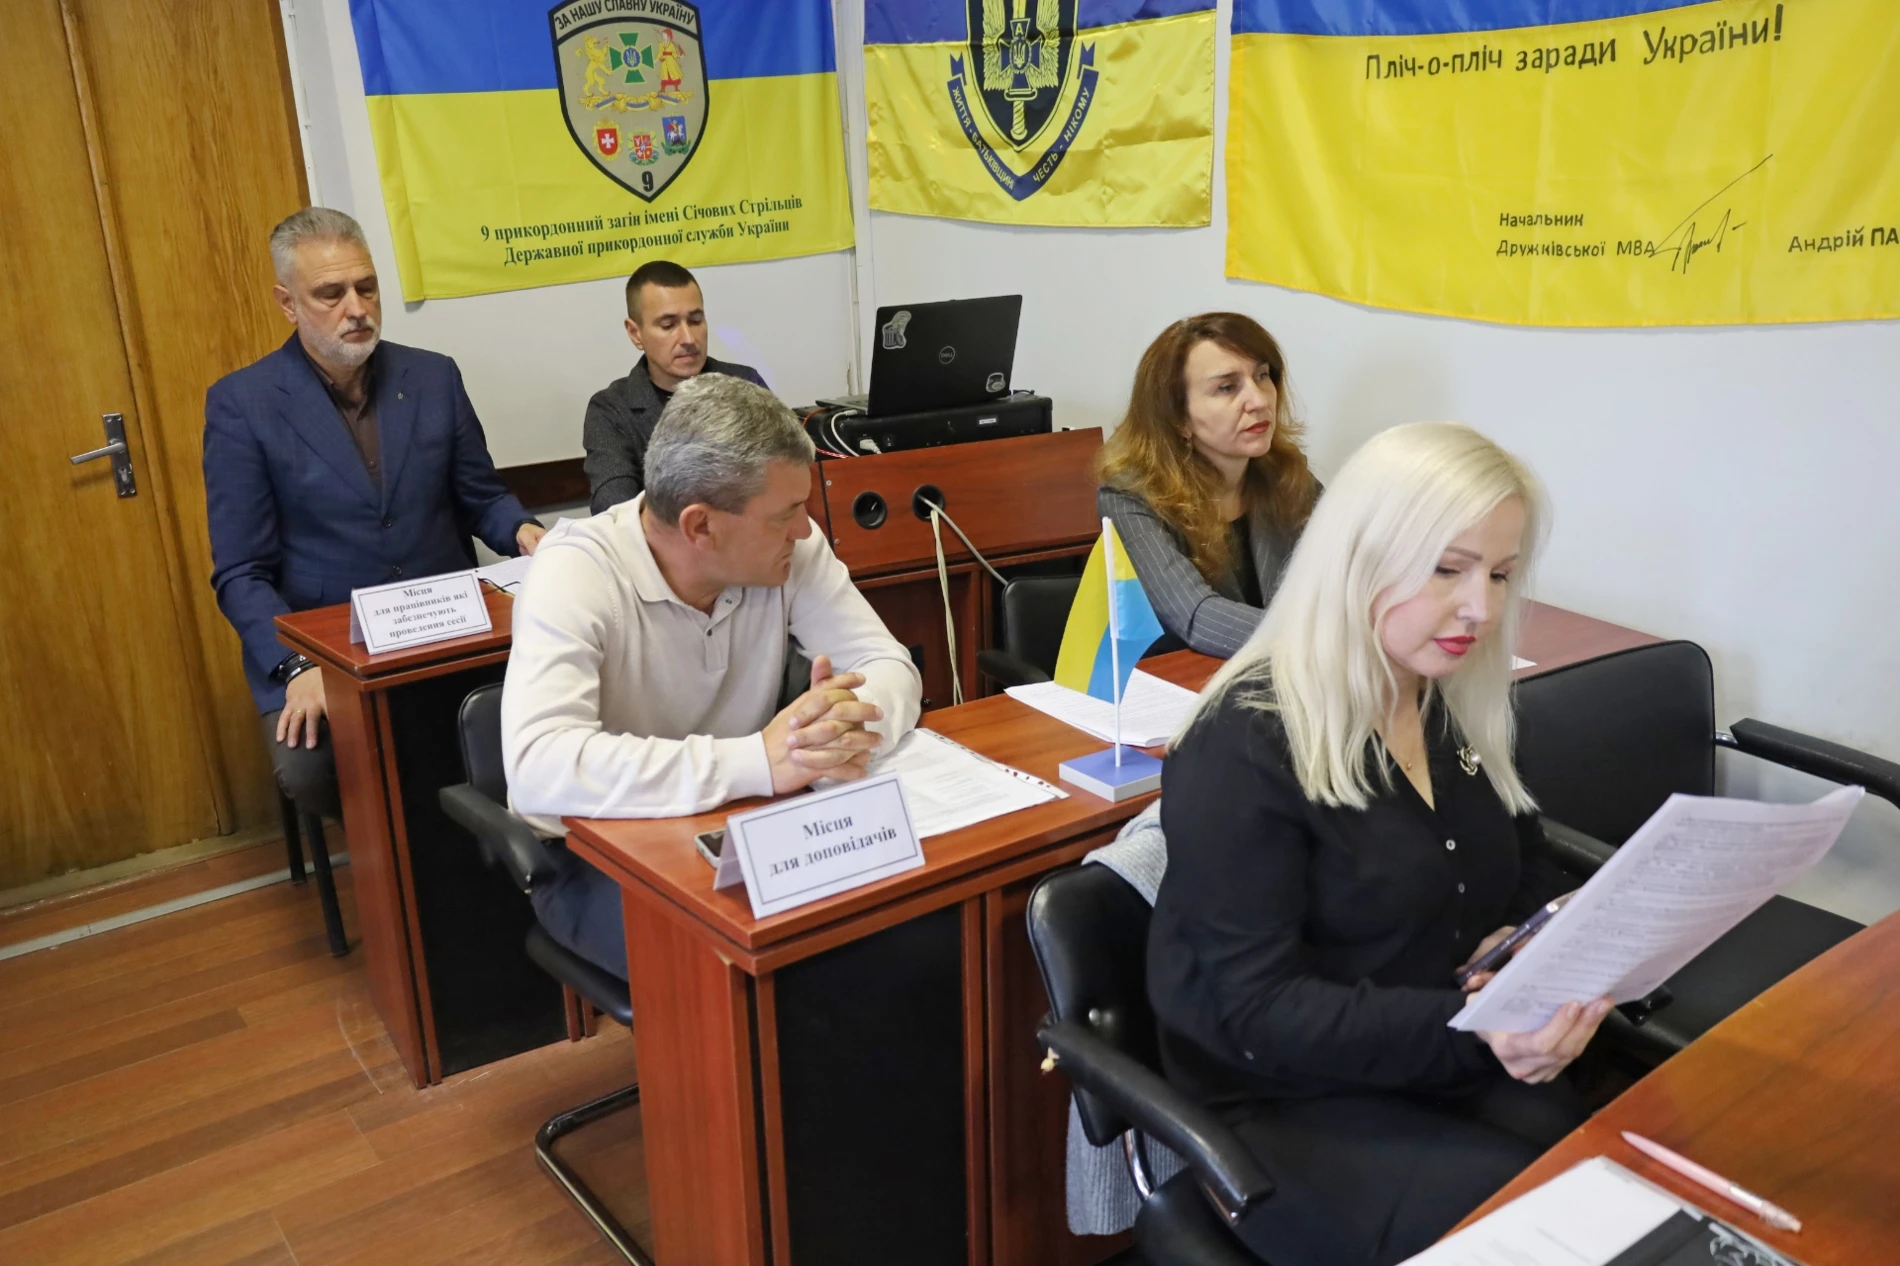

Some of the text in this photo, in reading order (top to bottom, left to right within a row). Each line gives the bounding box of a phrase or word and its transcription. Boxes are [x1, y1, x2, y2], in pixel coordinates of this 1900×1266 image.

[554, 0, 695, 30] ЗА НАШУ СЛАВНУ УКРАЇНУ
[1366, 3, 1784, 80] Пліч-о-пліч заради України!
[952, 86, 971, 127] ЖИТТЯ
[1032, 152, 1058, 182] ЧЕСТЬ
[1063, 87, 1090, 142] НІКОМУ
[642, 171, 654, 192] 9
[481, 195, 803, 243] 9 прикордонний загін імені Січових Стрільців
[1499, 213, 1584, 227] Начальник
[504, 220, 790, 266] Державної прикордонної служби України
[1496, 226, 1899, 257] Дружківської МВА Андрій ПА
[374, 590, 468, 617] для працівників які
[403, 587, 433, 598] Місця
[389, 615, 467, 638] проведення сесії
[393, 606, 457, 625] забезпечують
[802, 816, 854, 840] Місця
[769, 826, 897, 878] для доповідачів
